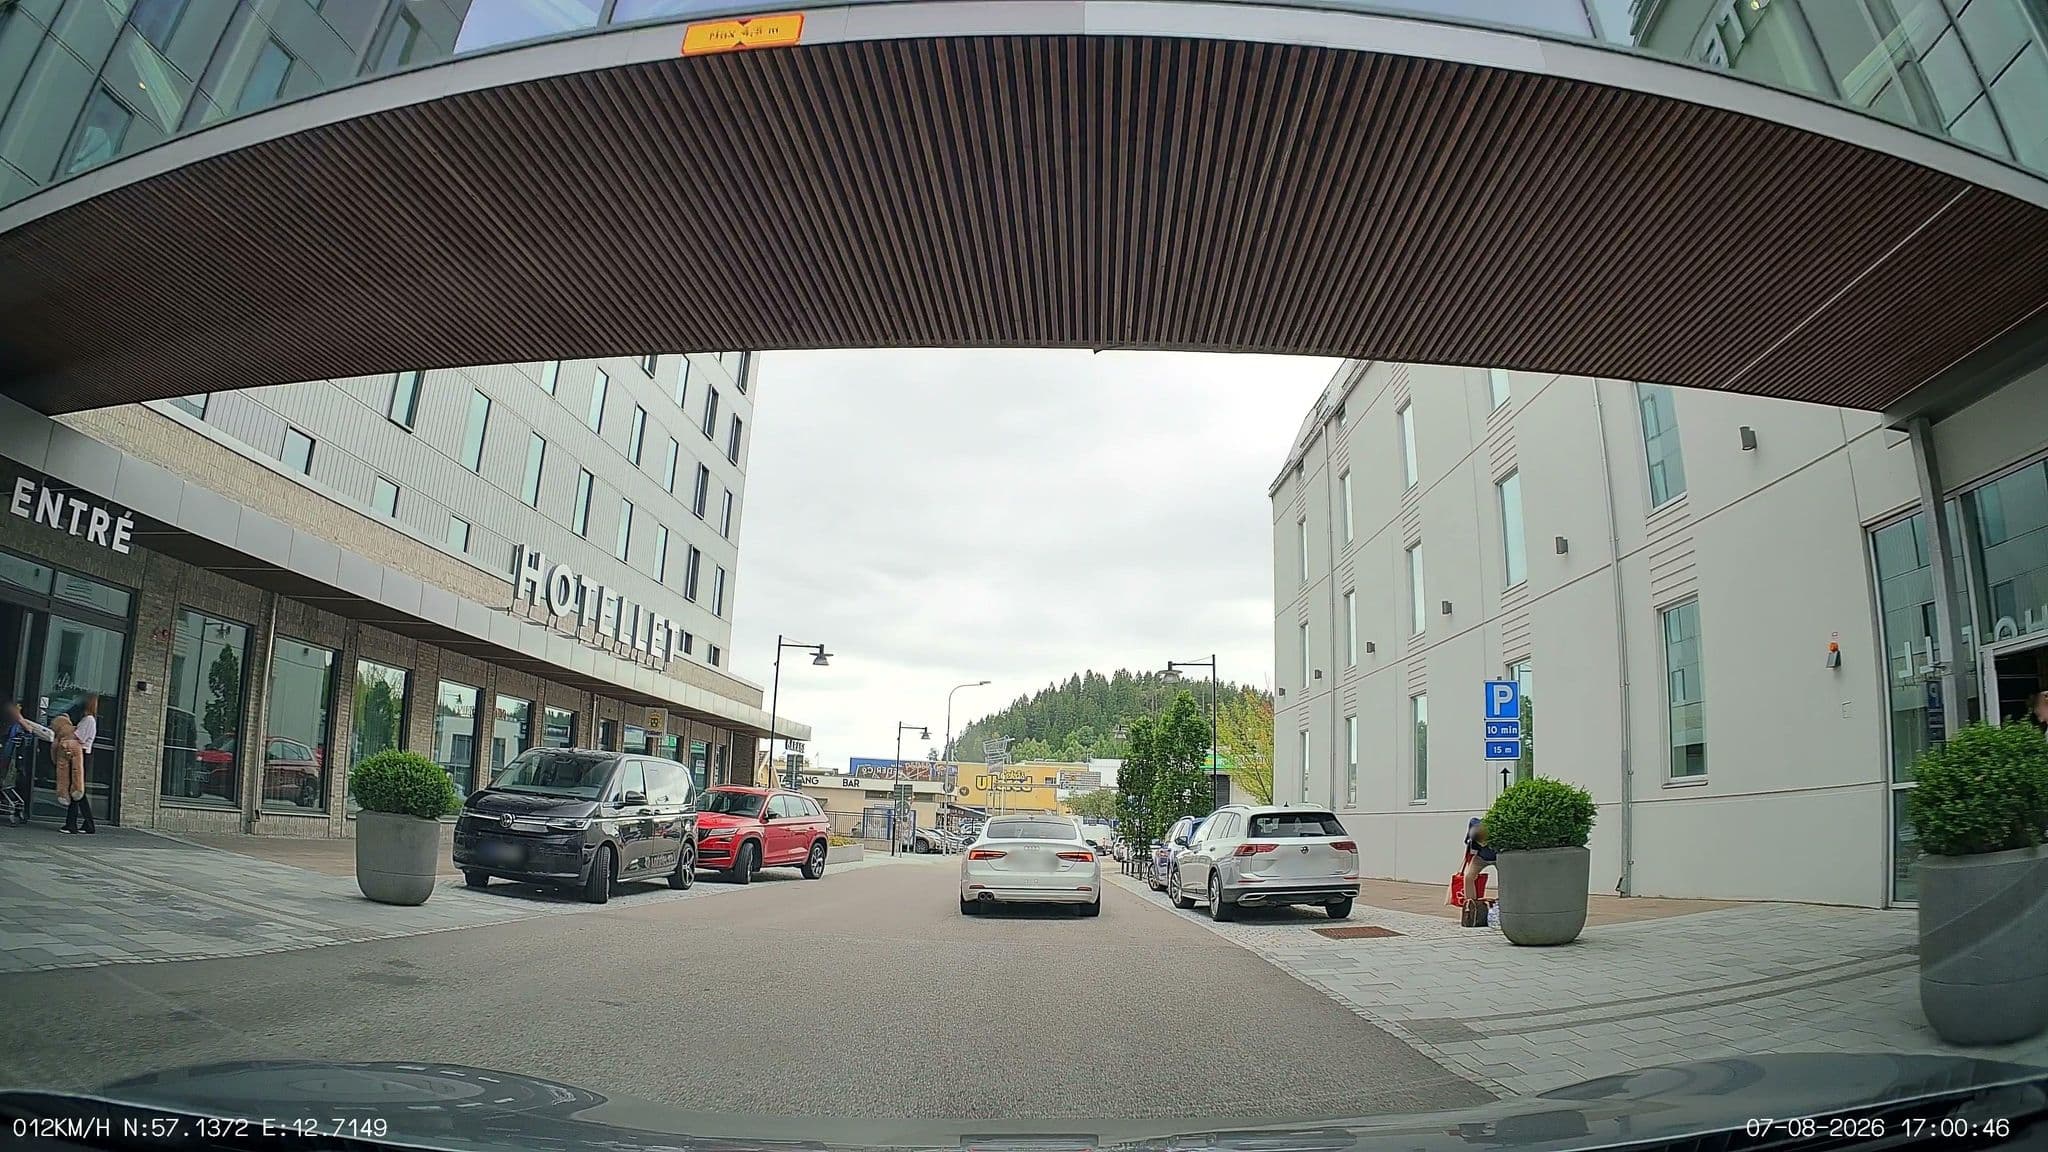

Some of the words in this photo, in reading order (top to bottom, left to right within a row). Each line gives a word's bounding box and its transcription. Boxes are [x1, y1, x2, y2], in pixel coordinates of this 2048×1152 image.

[10, 477, 134, 555] ENTRÉ
[514, 543, 680, 662] HOTELLET
[1493, 684, 1513, 716] P
[1487, 725, 1498, 734] 10
[1500, 725, 1518, 735] min
[1493, 746, 1502, 754] 15
[842, 778, 860, 787] BAR
